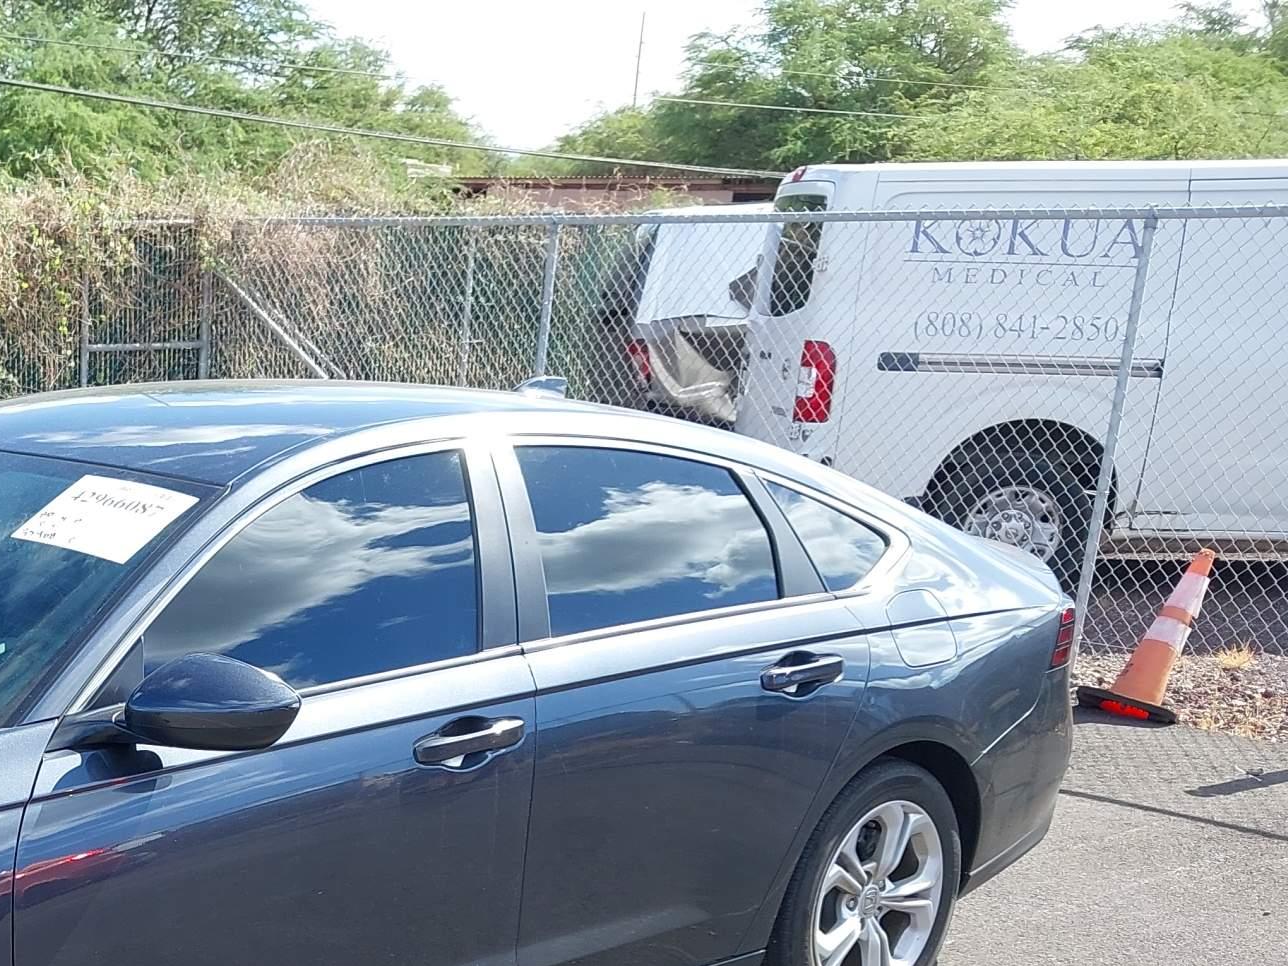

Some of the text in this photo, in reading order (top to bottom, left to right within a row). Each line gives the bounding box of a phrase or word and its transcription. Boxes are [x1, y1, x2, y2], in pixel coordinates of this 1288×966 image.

[904, 218, 1143, 258] KOKUA
[932, 267, 1105, 288] MEDICAL
[914, 311, 1118, 342] (808) 841-2850
